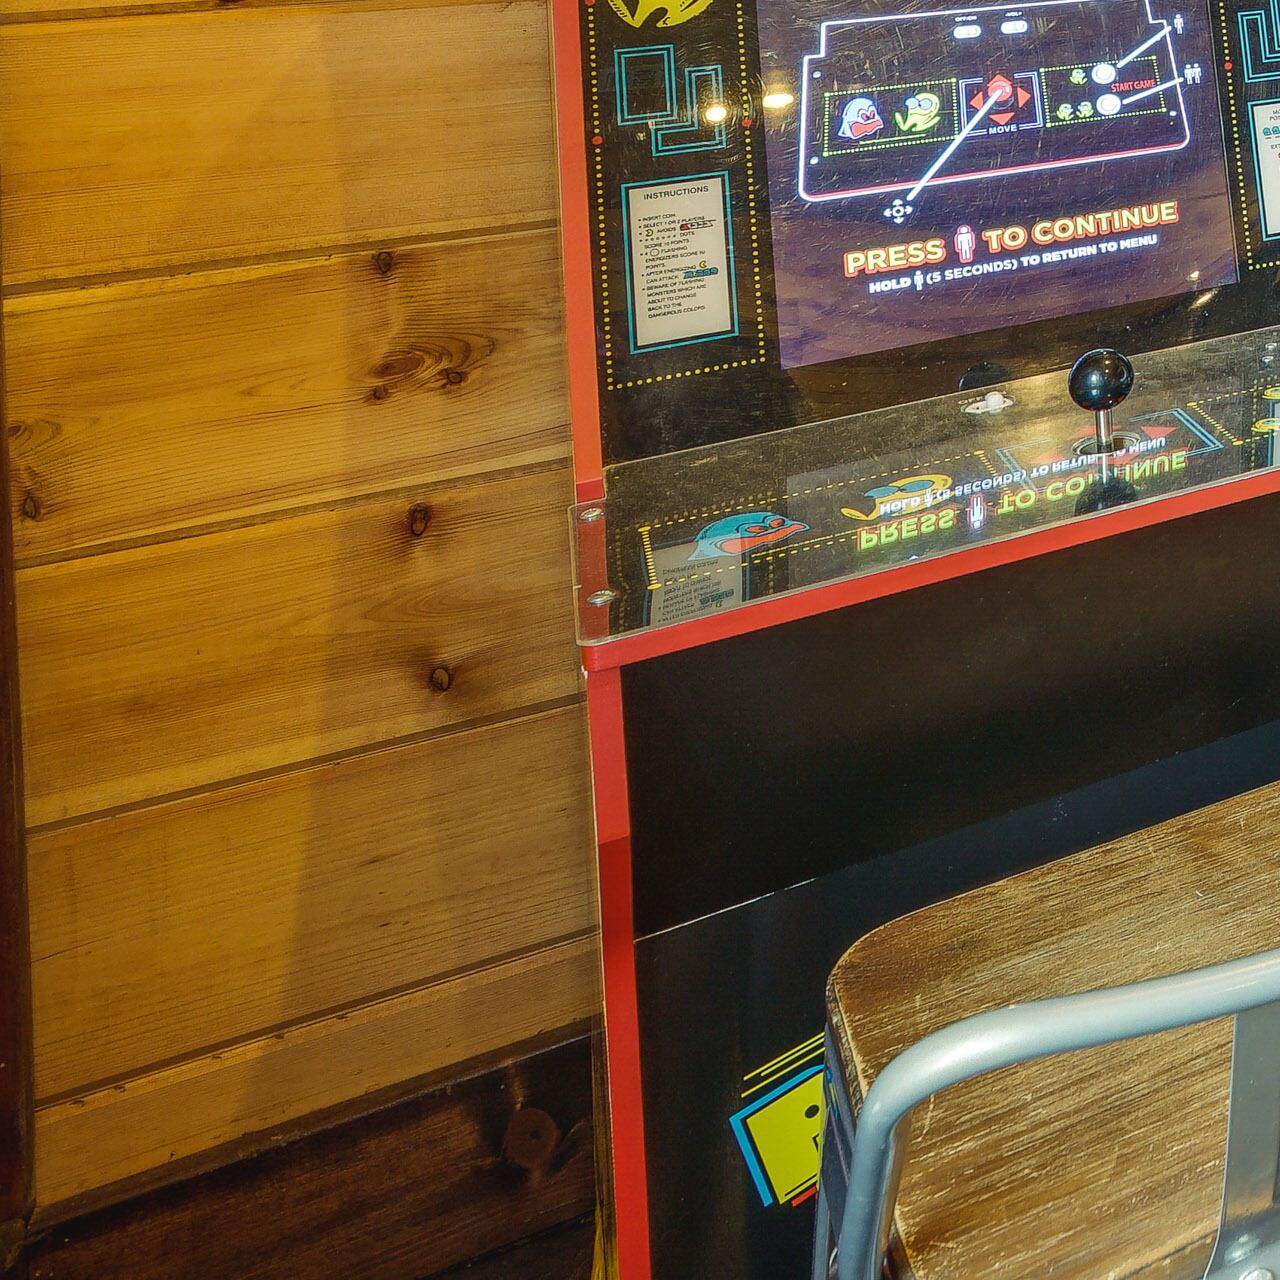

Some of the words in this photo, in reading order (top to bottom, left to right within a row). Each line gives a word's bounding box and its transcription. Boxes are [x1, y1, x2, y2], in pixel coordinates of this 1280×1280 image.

[1111, 81, 1133, 93] START
[1134, 79, 1157, 90] GAME
[988, 123, 1018, 135] MOVE
[643, 185, 709, 200] INSTRUCTIONS
[845, 238, 946, 277] PRESS
[982, 226, 1028, 252] TO
[1032, 201, 1179, 243] CONTINUE
[869, 277, 911, 294] HOLD
[926, 270, 942, 286] (5
[944, 258, 1019, 282] SECONDS)
[1020, 254, 1040, 268] TO
[1042, 246, 1097, 264] RETURN
[1099, 241, 1119, 254] TO
[1120, 234, 1158, 250] MENU
